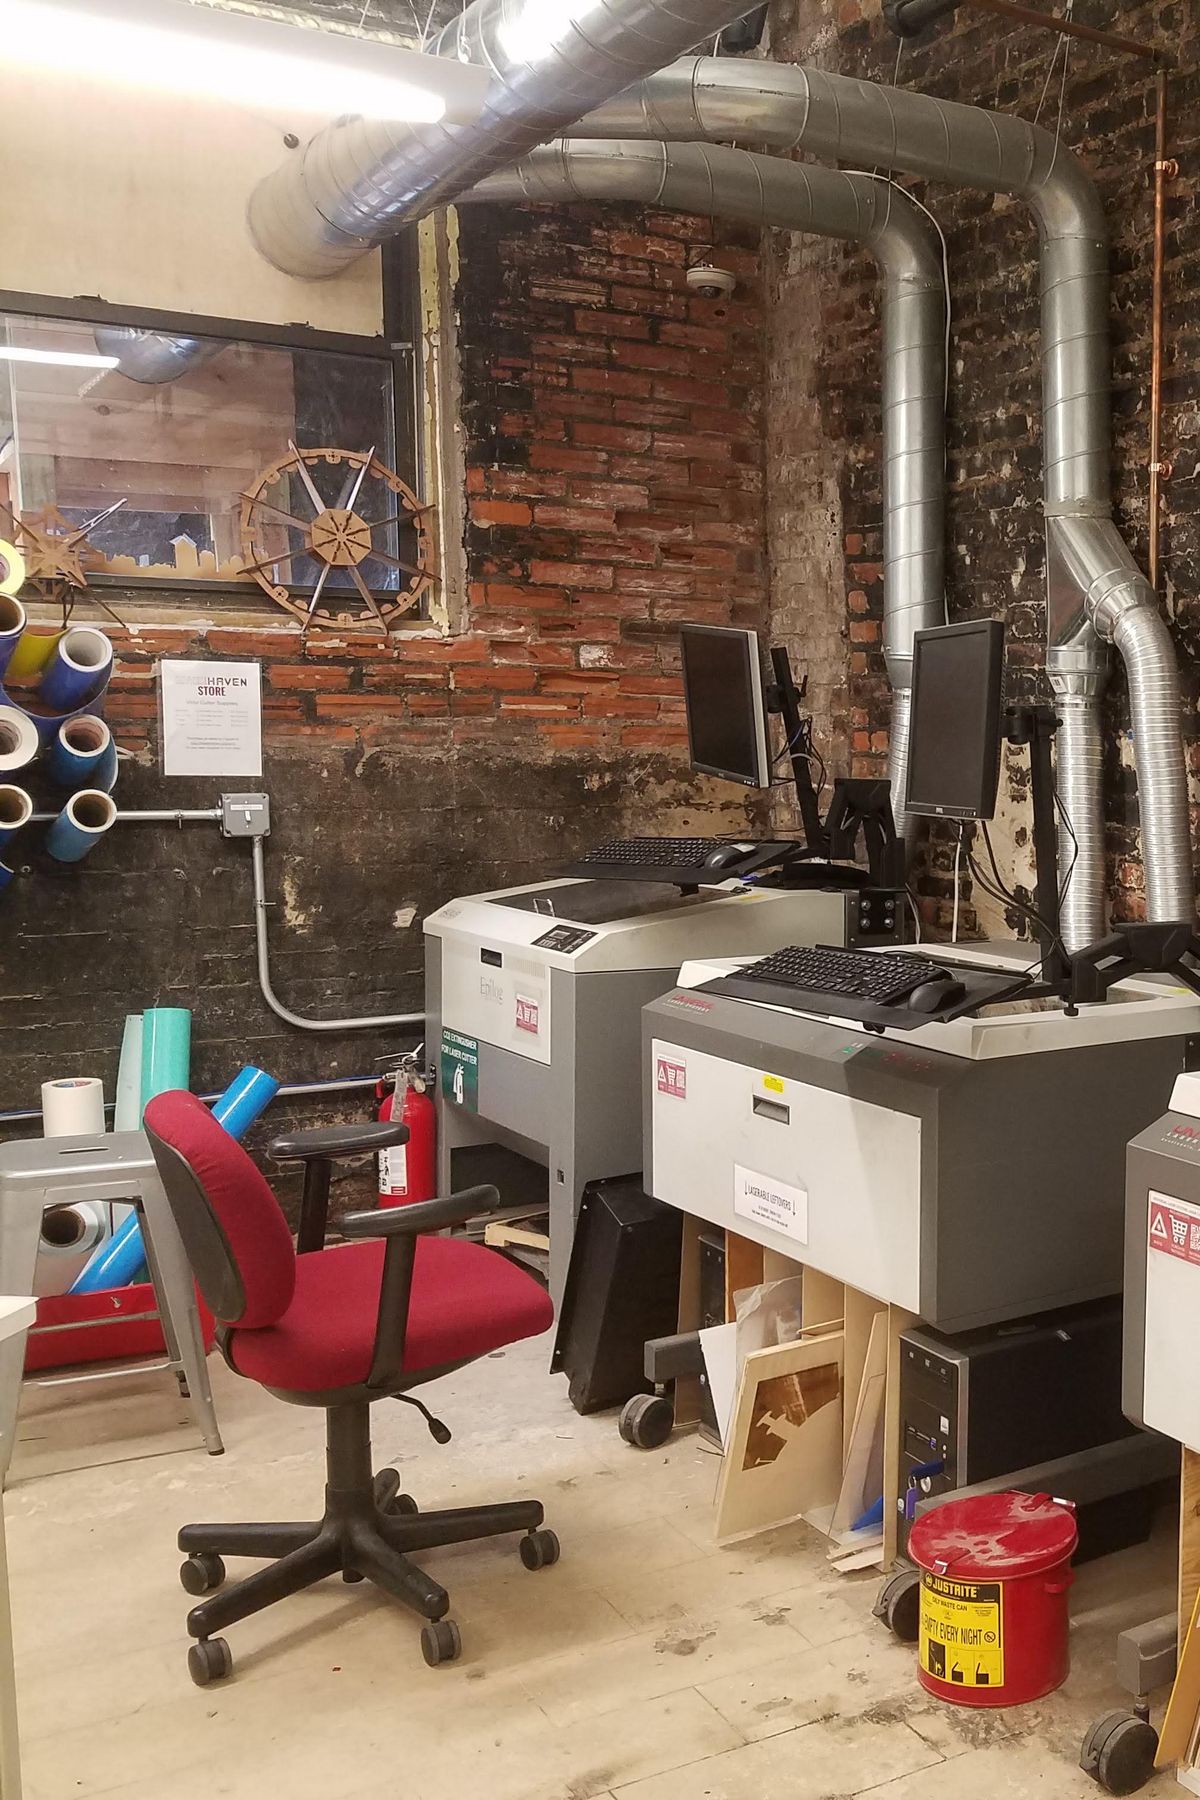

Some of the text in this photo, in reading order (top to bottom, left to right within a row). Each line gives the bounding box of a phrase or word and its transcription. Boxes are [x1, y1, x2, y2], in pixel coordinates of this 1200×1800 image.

[198, 686, 226, 696] STORE
[932, 1578, 978, 1598] JUSTRITE
[956, 1604, 968, 1612] CAN
[940, 1622, 959, 1642] EVERY
[960, 1628, 982, 1646] NIGHT
